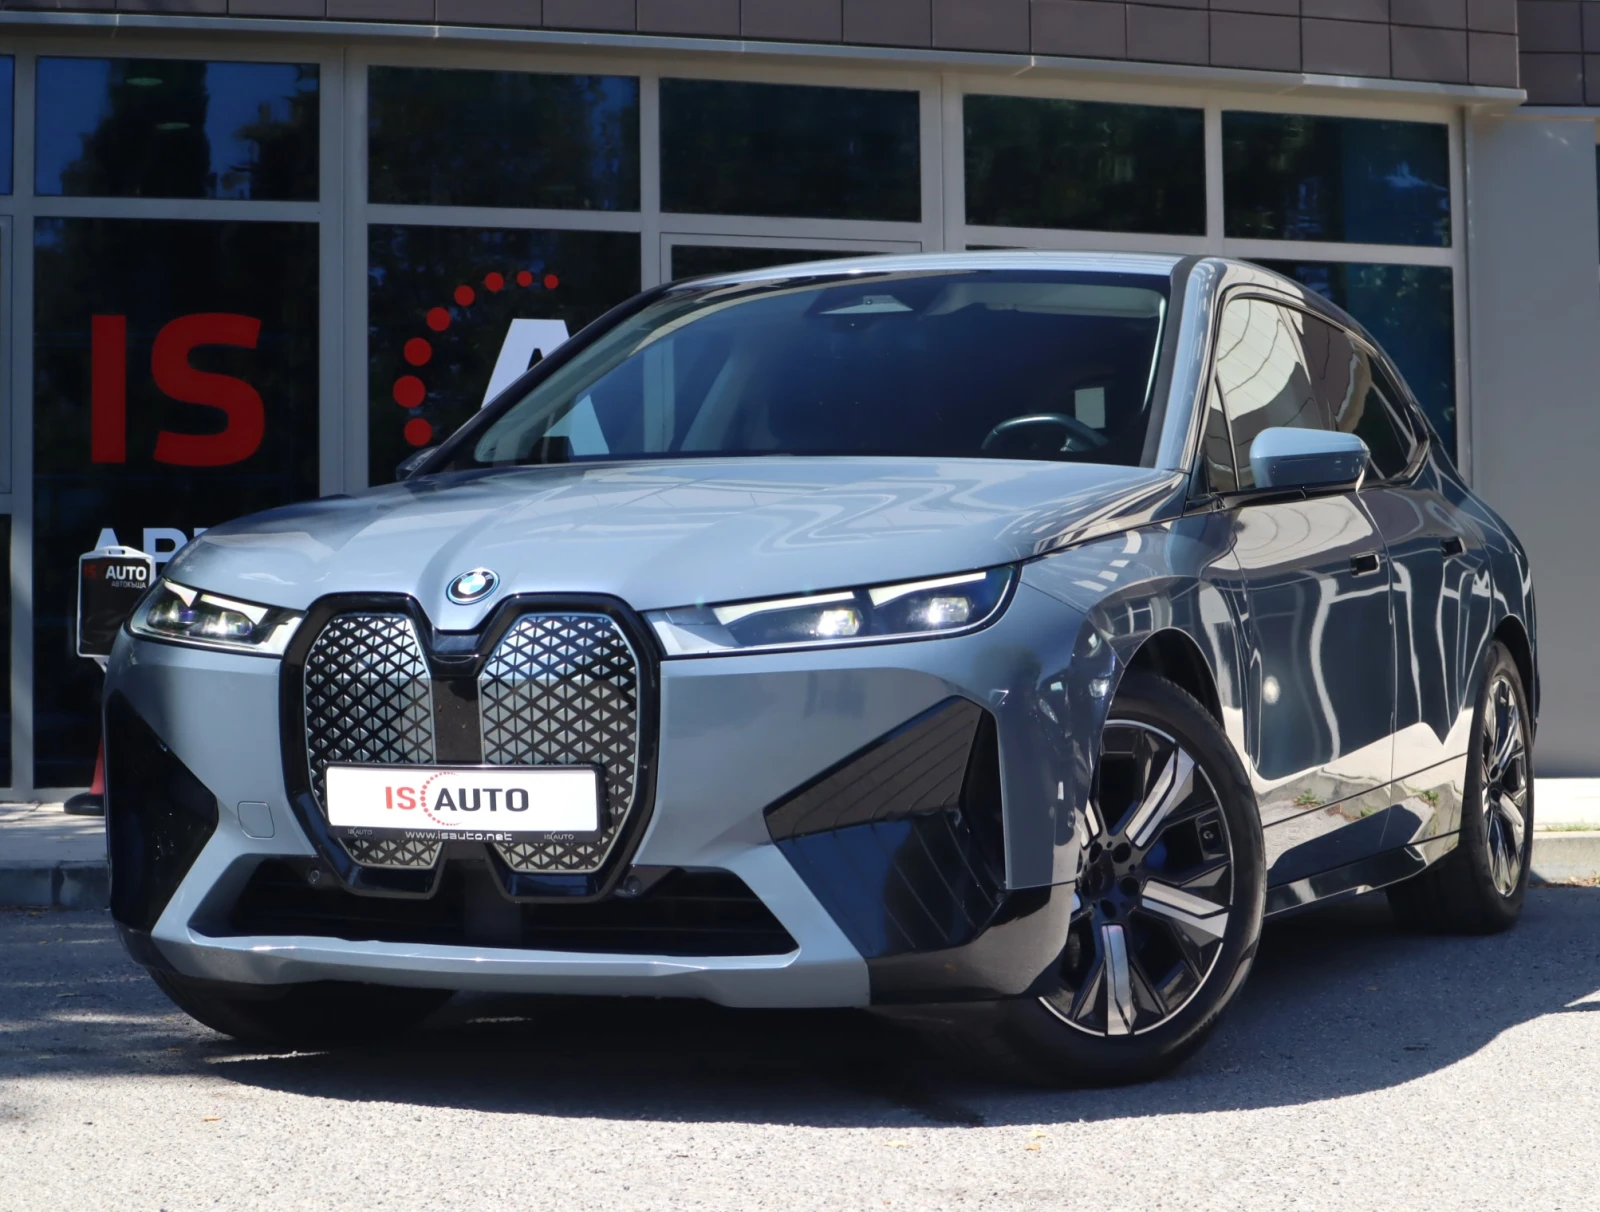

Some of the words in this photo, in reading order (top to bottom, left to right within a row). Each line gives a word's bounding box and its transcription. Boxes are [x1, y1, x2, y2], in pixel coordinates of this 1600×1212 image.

[91, 312, 265, 467] IS
[83, 563, 97, 579] IS
[105, 565, 147, 581] AUTO
[385, 786, 417, 810] IS
[434, 787, 529, 812] AUTO
[405, 830, 513, 842] www.isauto.net
